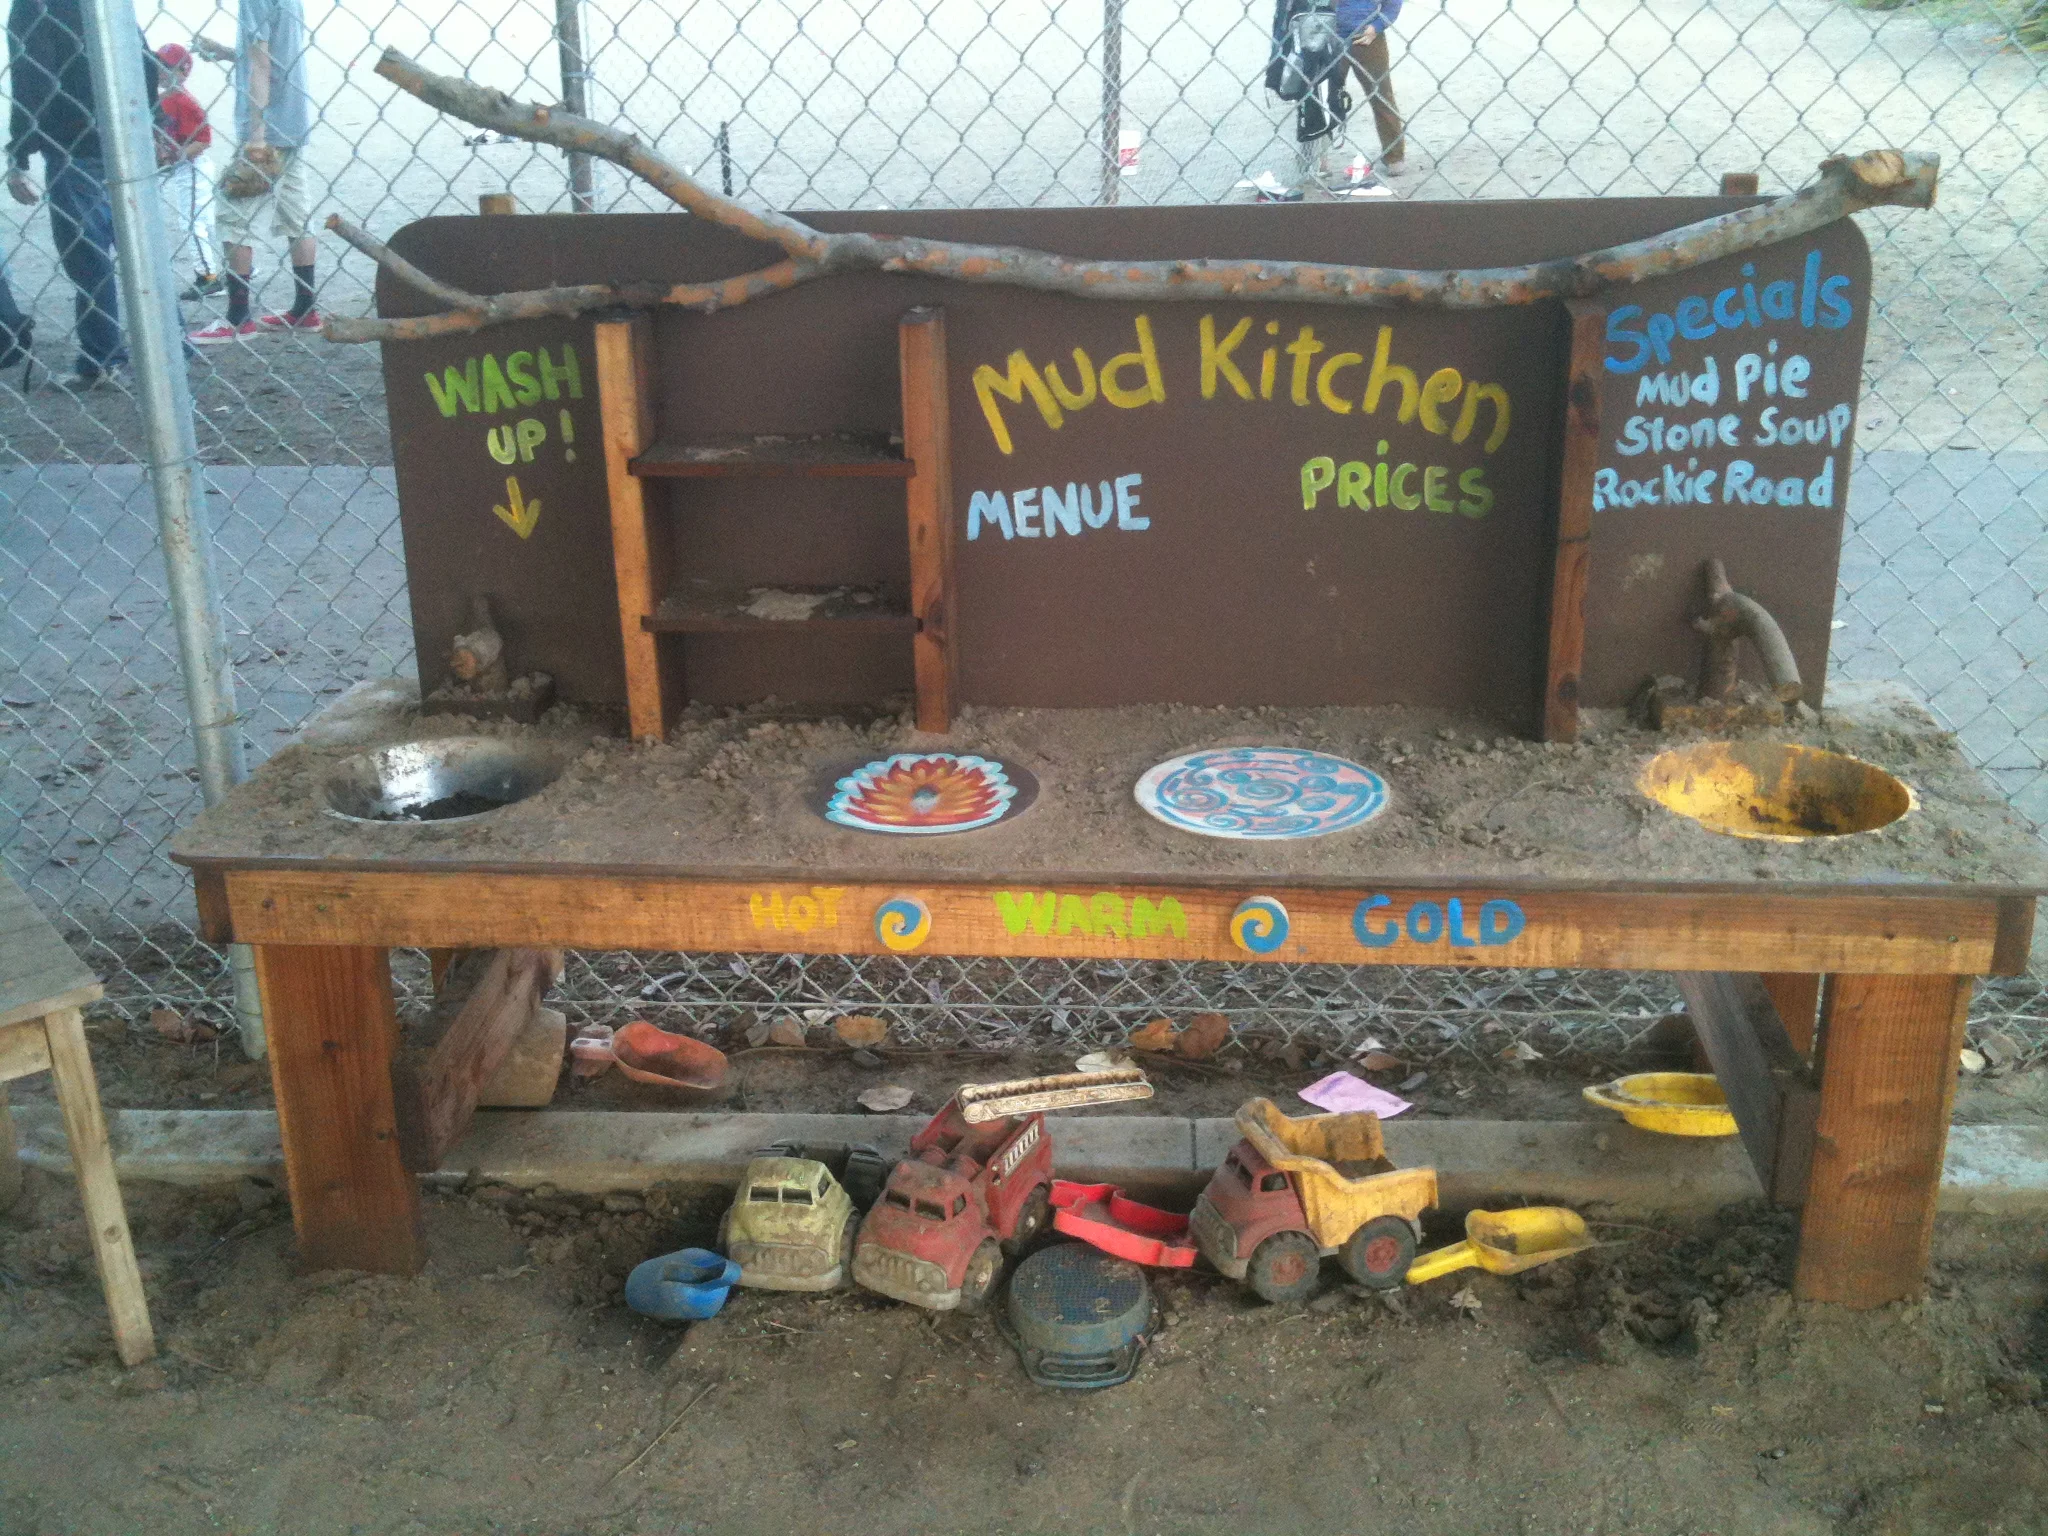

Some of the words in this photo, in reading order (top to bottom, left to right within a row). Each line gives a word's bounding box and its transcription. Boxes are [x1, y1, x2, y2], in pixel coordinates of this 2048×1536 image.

[1604, 250, 1852, 374] Specials
[424, 343, 583, 418] WASH
[972, 314, 1165, 454] Mud
[1199, 315, 1511, 453] Kitchen
[1636, 356, 1720, 408] Mud
[1735, 339, 1811, 402] Pie
[1615, 414, 1742, 456] Stone
[1754, 403, 1851, 447] Soup
[967, 472, 1150, 541] MENUE
[1592, 457, 1717, 512] Rockie
[1721, 455, 1835, 508] Road
[748, 886, 844, 931] HOT
[995, 889, 1188, 940] WARM
[1353, 893, 1526, 947] COLD
